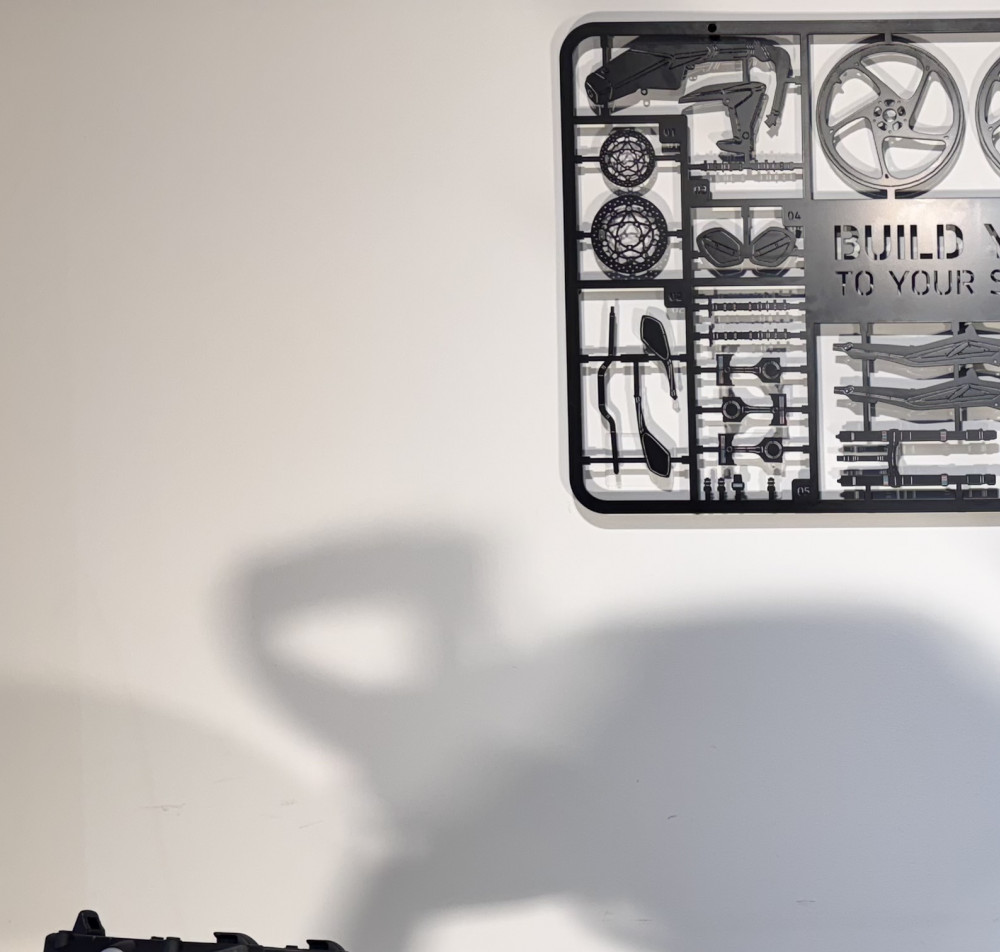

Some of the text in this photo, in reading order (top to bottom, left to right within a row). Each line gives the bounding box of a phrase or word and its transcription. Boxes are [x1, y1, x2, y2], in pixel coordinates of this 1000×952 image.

[787, 211, 801, 220] 04
[834, 224, 964, 260] BUILD
[835, 270, 875, 296] TO
[889, 269, 975, 296] YOUR
[797, 487, 811, 496] 05
